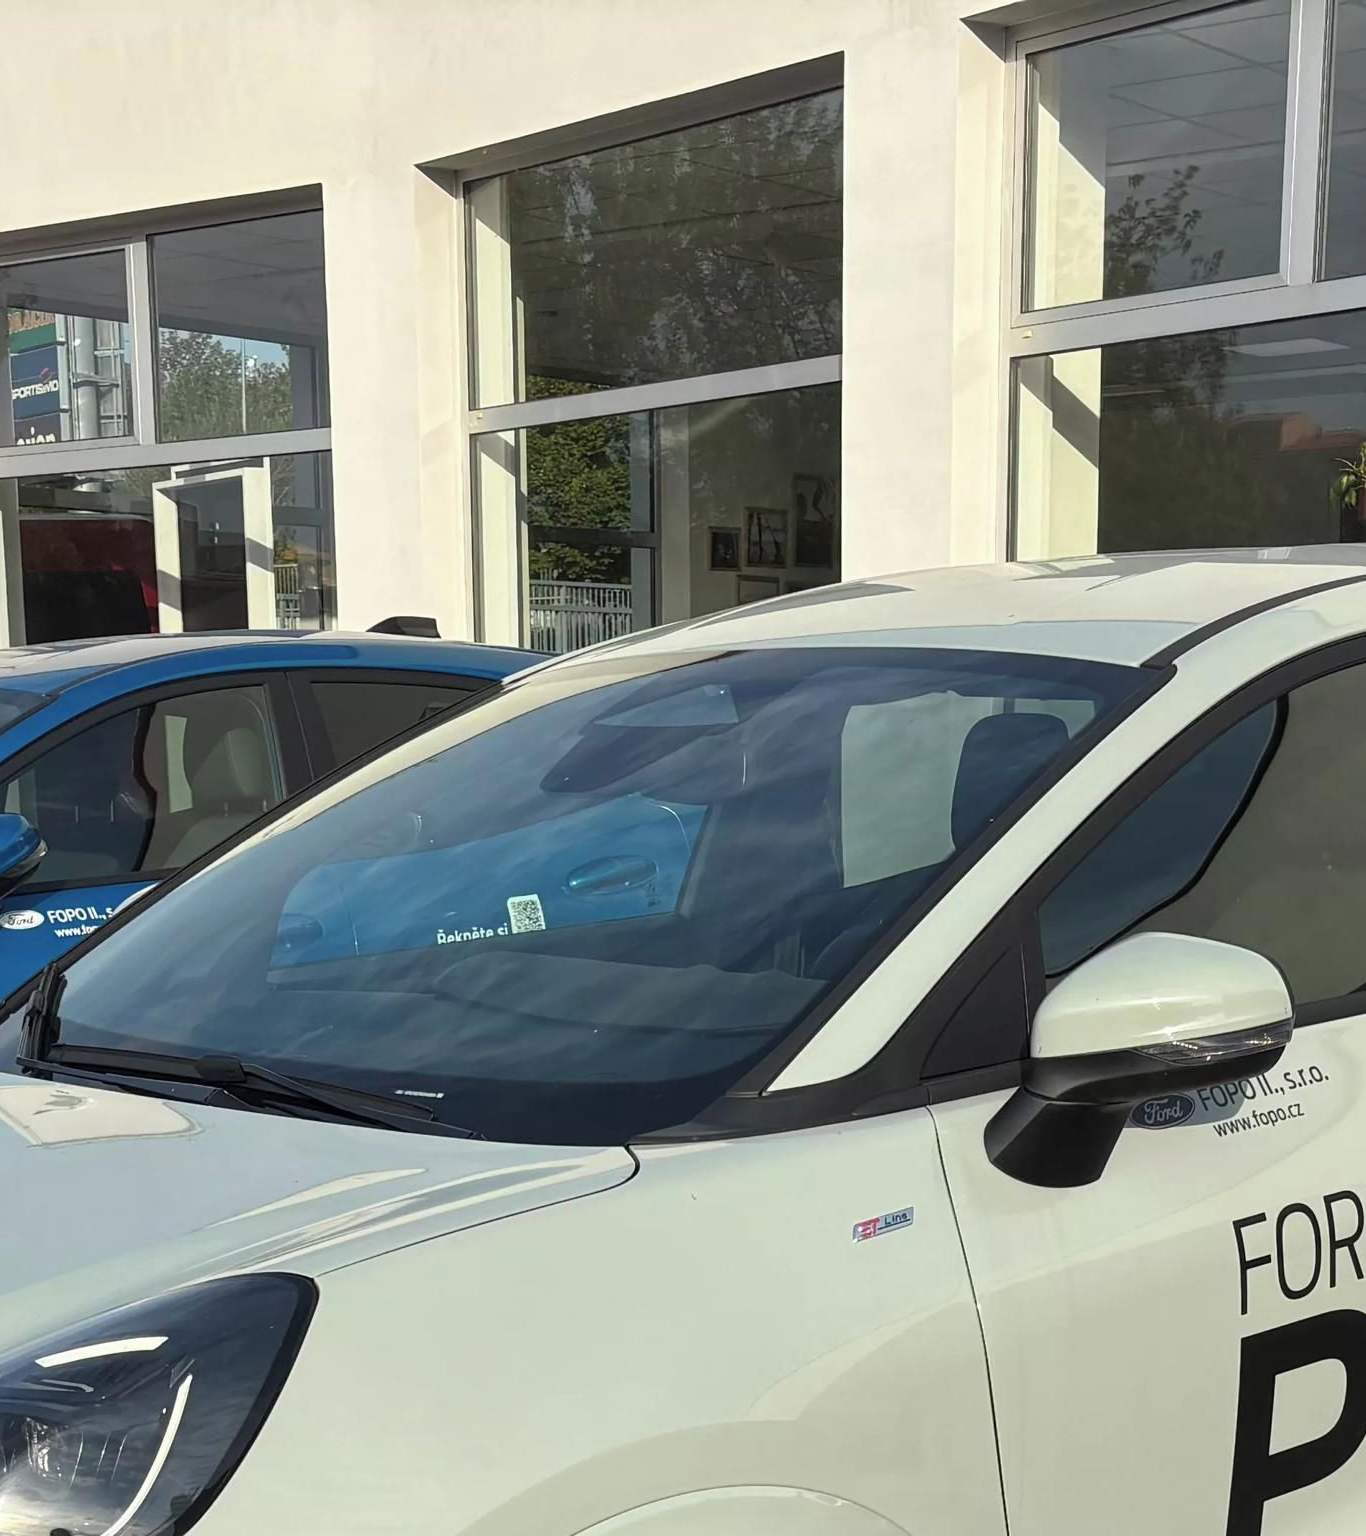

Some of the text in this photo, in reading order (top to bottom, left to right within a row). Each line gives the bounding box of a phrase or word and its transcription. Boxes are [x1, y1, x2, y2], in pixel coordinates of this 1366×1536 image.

[7, 913, 35, 926] Ford
[47, 907, 88, 924] FOPO
[1197, 1077, 1257, 1112] FOPO
[1283, 1065, 1330, 1090] s.r.o.
[1144, 1098, 1185, 1125] Ford
[1213, 1103, 1305, 1137] www.fopo.cz
